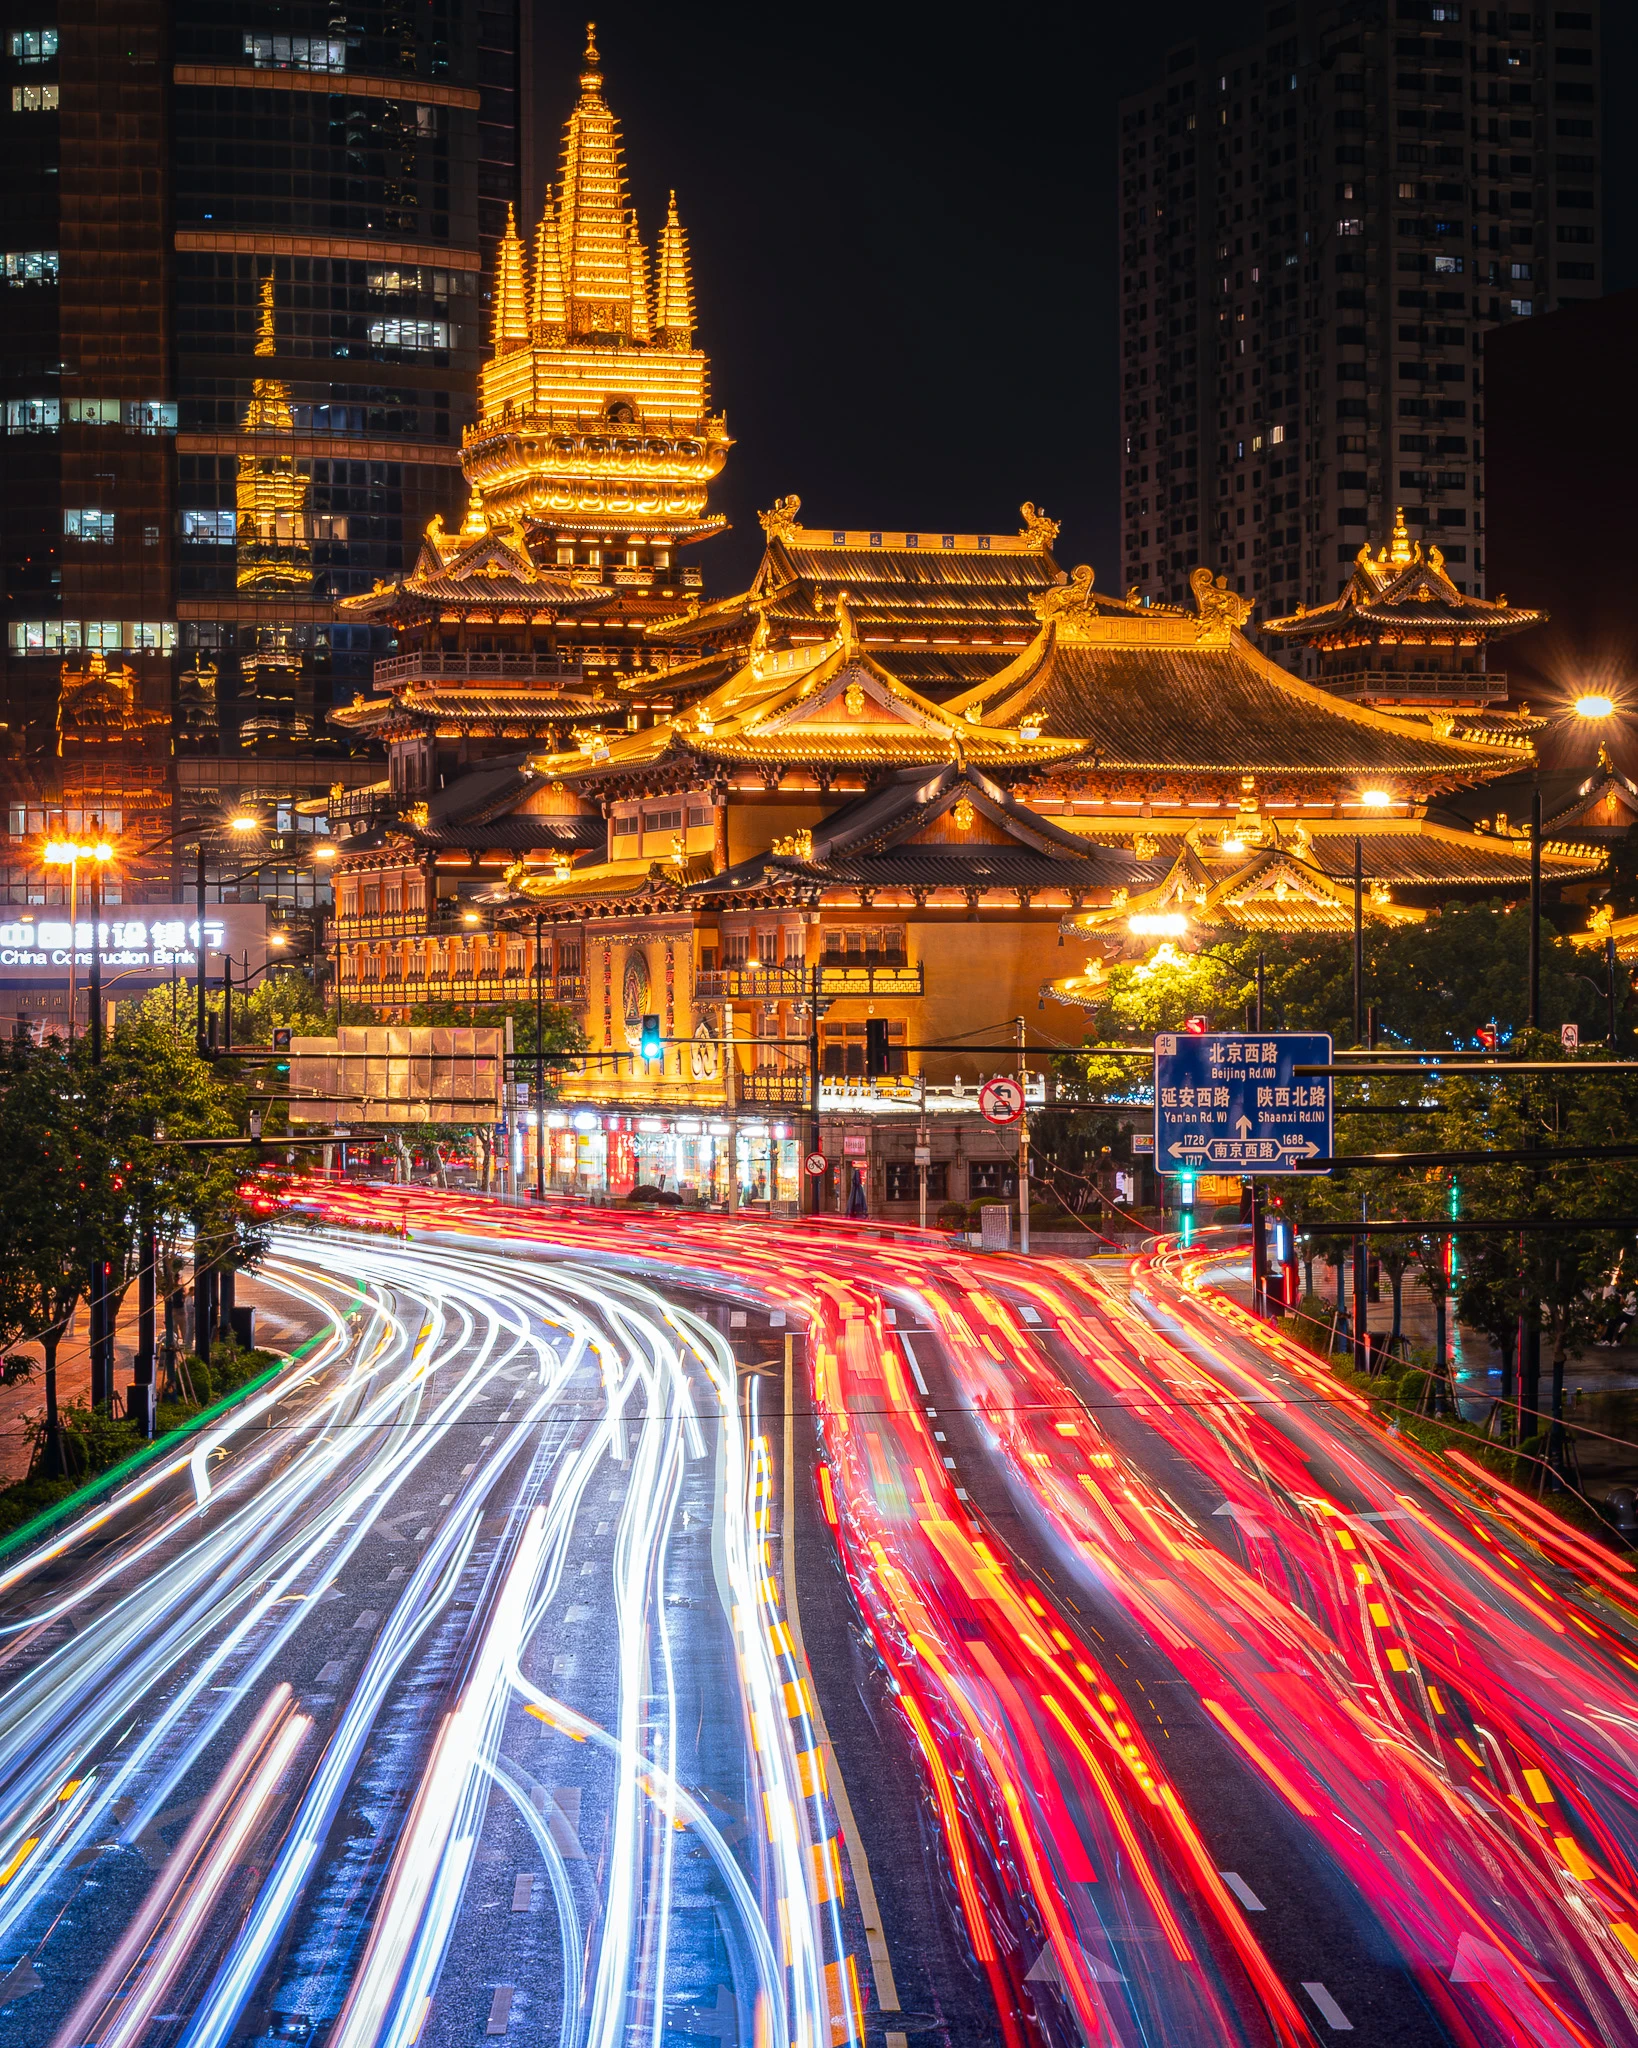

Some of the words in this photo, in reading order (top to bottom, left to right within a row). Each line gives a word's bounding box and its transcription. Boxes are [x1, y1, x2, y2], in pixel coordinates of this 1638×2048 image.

[1, 950, 47, 965] China
[51, 950, 150, 965] Consruction
[153, 950, 196, 965] Bank
[1160, 1037, 1171, 1047] 北
[1209, 1042, 1279, 1064] 北京西路
[1211, 1067, 1247, 1082] Beijing
[1249, 1067, 1276, 1079] Rd.(W)
[1161, 1086, 1231, 1108] 延安西路
[1257, 1086, 1326, 1108] 陕西北路
[1164, 1111, 1197, 1123] Yan'an
[1200, 1111, 1215, 1123] Rd.
[1258, 1111, 1297, 1123] Shaanxi
[1299, 1111, 1325, 1122] Rd.(N)
[1184, 1134, 1205, 1146] 1728
[1283, 1134, 1304, 1145] 1688
[1214, 1142, 1274, 1158] 南京西路
[1185, 1155, 1203, 1166] 1717
[1285, 1154, 1304, 1166] 16
